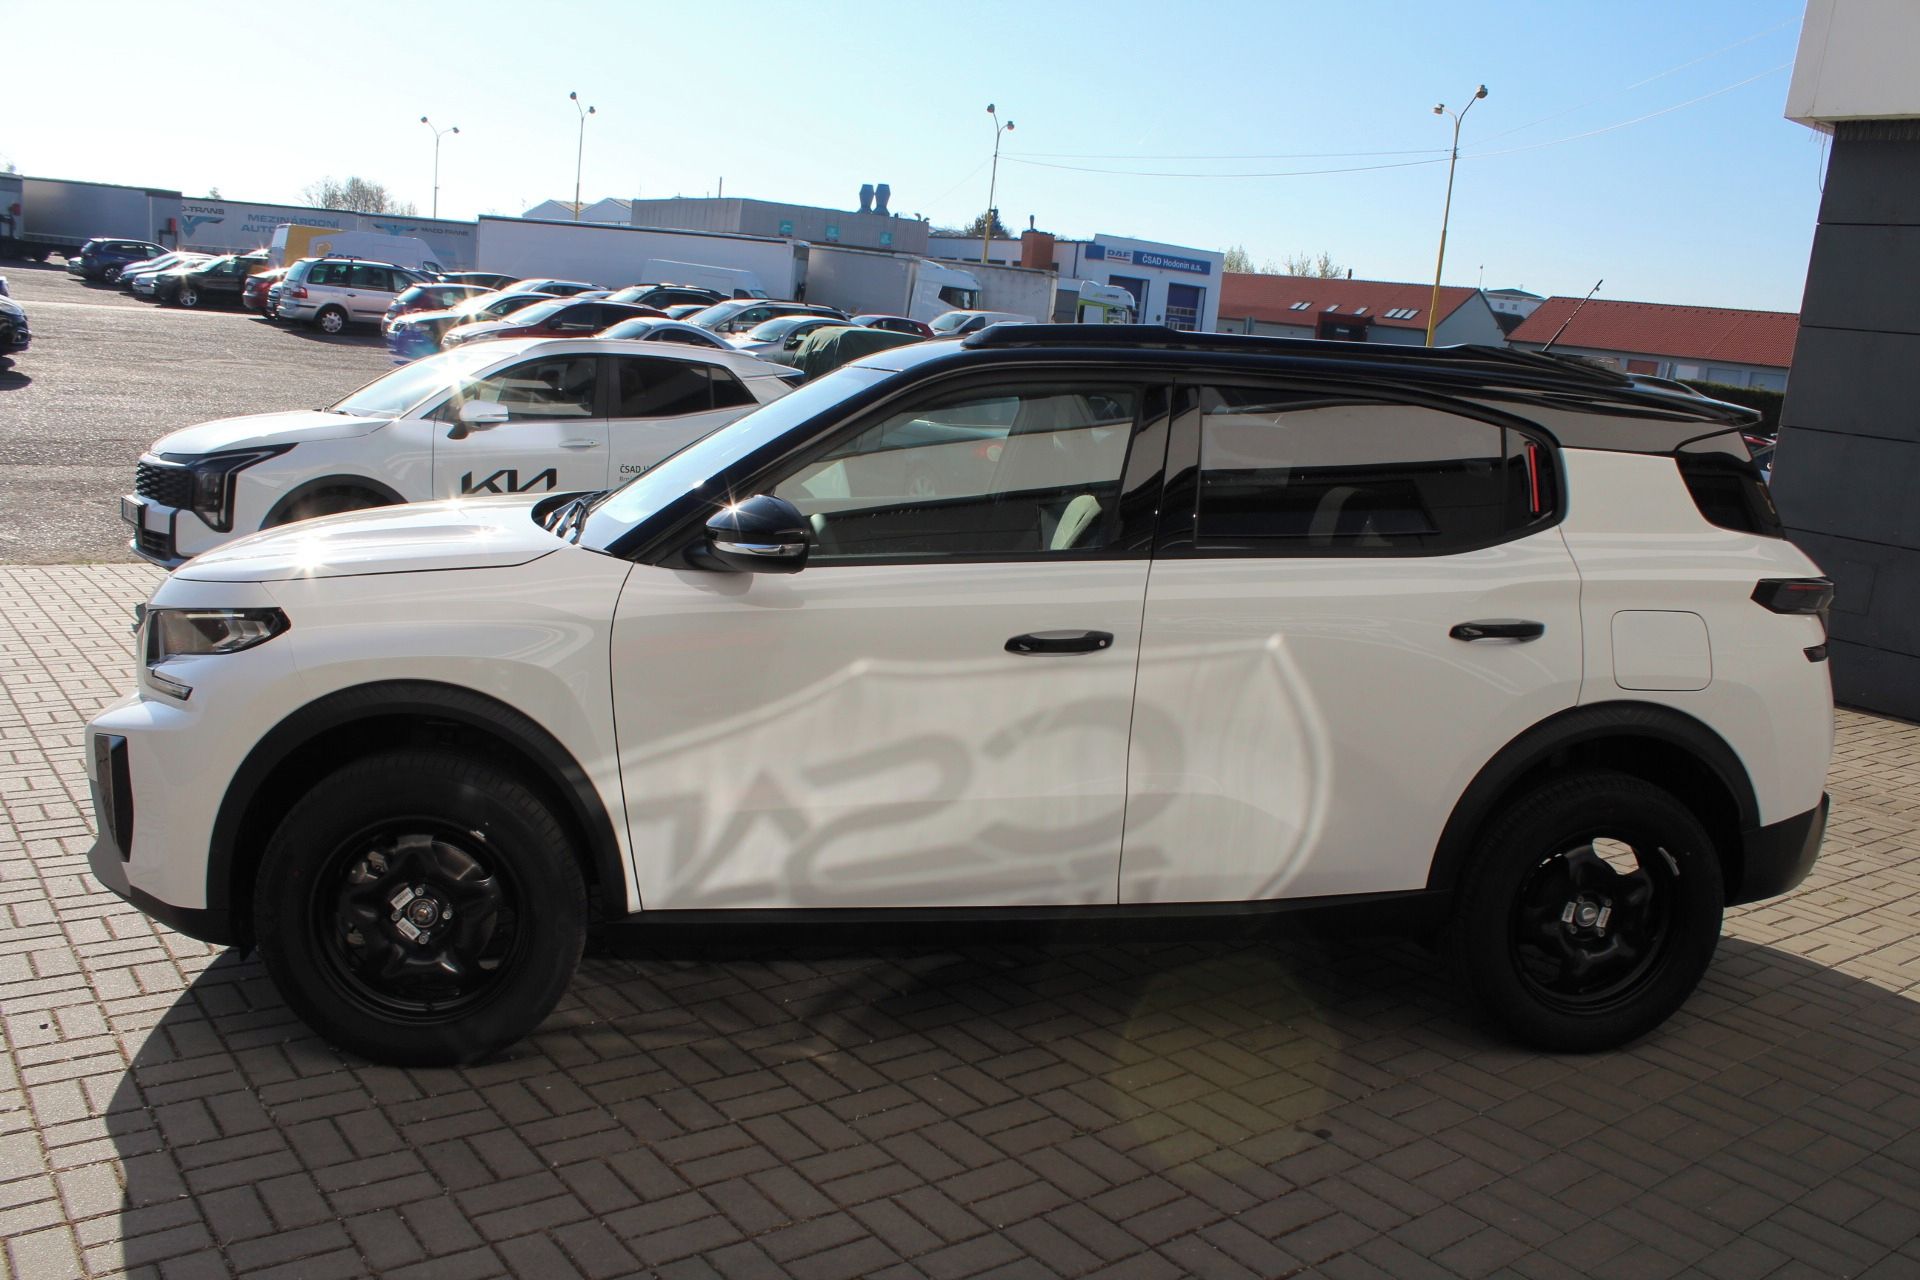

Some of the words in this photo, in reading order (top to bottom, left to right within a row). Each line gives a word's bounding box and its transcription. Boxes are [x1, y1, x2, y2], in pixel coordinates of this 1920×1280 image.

[1107, 249, 1131, 258] DAF
[1142, 253, 1162, 265] ČSAD
[619, 463, 641, 474] ČSAD
[461, 467, 558, 495] KIA
